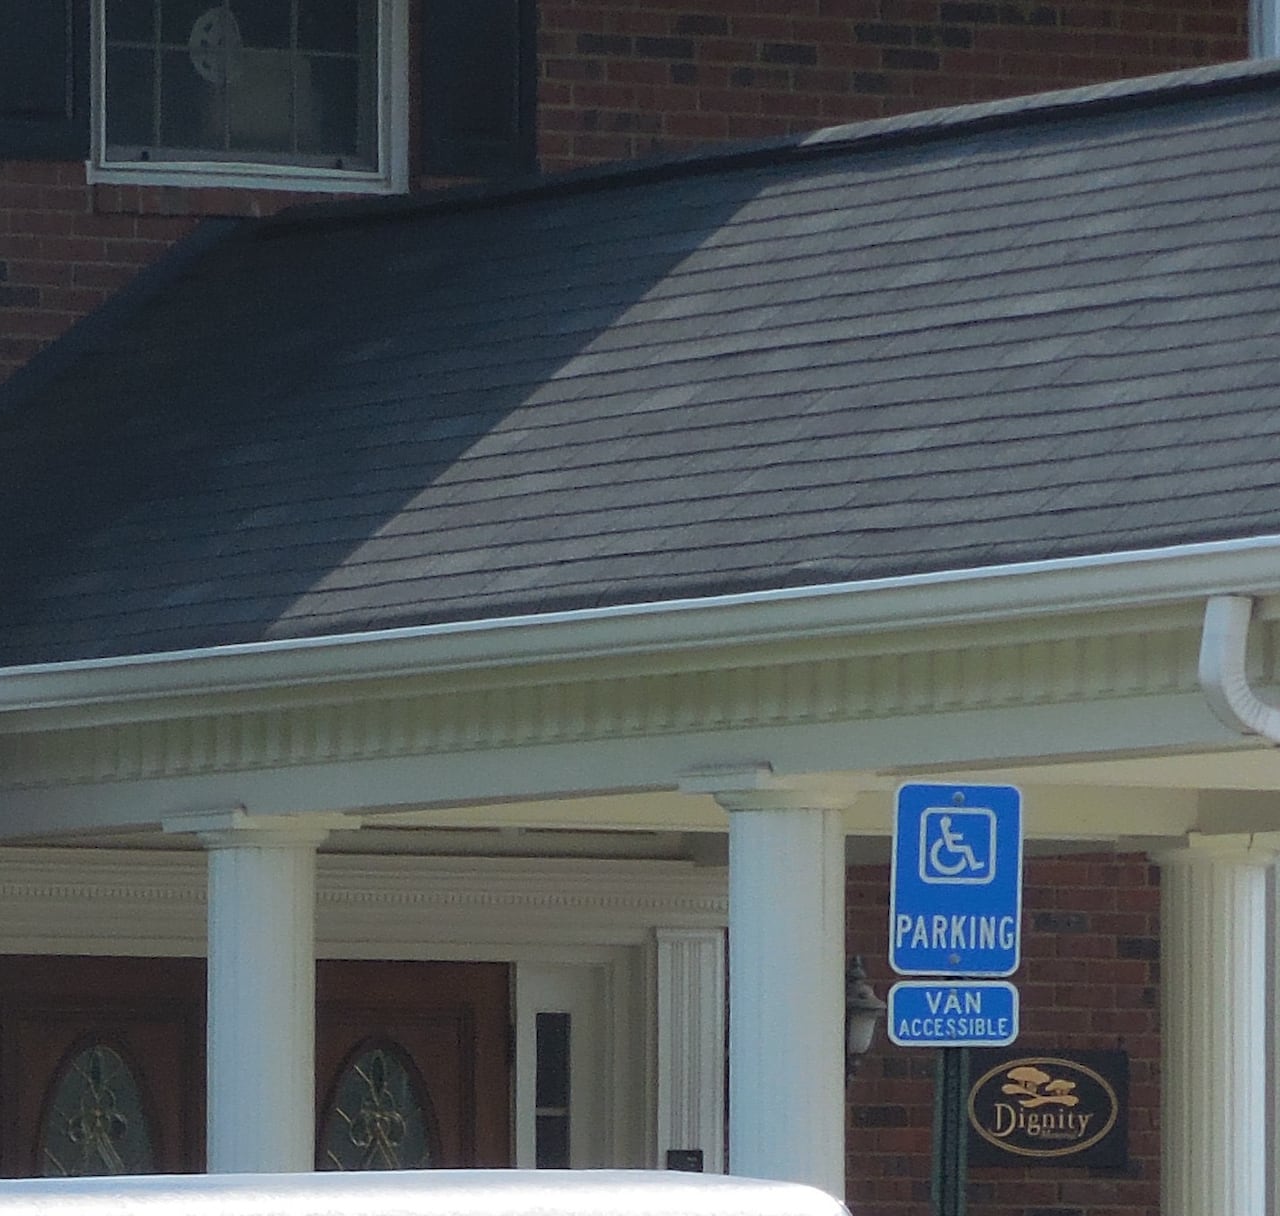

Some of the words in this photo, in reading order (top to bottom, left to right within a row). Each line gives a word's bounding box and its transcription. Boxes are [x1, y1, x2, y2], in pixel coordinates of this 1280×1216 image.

[896, 914, 1014, 950] PARKING
[925, 991, 981, 1015] VAN
[898, 1018, 1010, 1038] ACCESSIBLE
[987, 1102, 1094, 1138] Dignity
